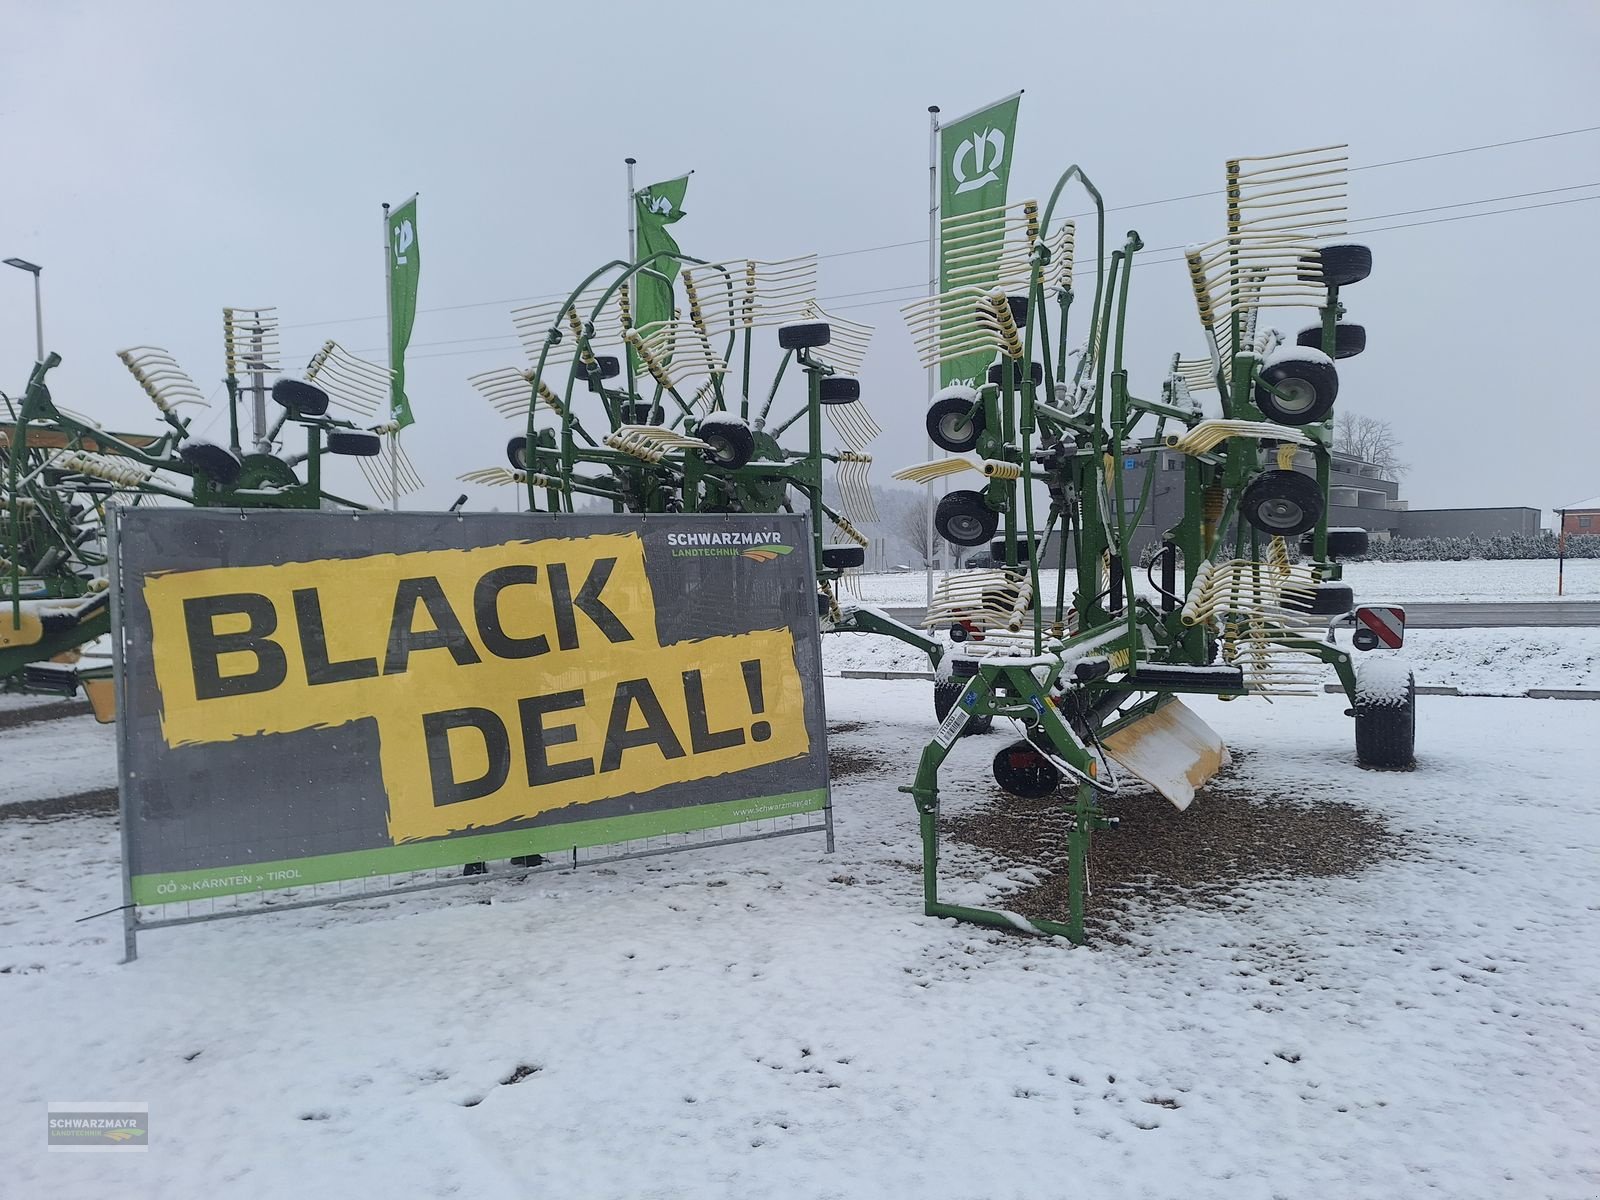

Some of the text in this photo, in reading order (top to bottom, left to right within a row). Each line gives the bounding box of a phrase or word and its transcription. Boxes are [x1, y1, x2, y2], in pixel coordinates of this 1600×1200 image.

[667, 532, 782, 546] SCHWARZMAYR
[672, 547, 740, 557] LANDTECHNIK
[182, 557, 635, 700] BLACK
[421, 659, 773, 807] DEAL!
[733, 798, 812, 816] www.schwarzmayr.at
[267, 869, 302, 881] TIROL
